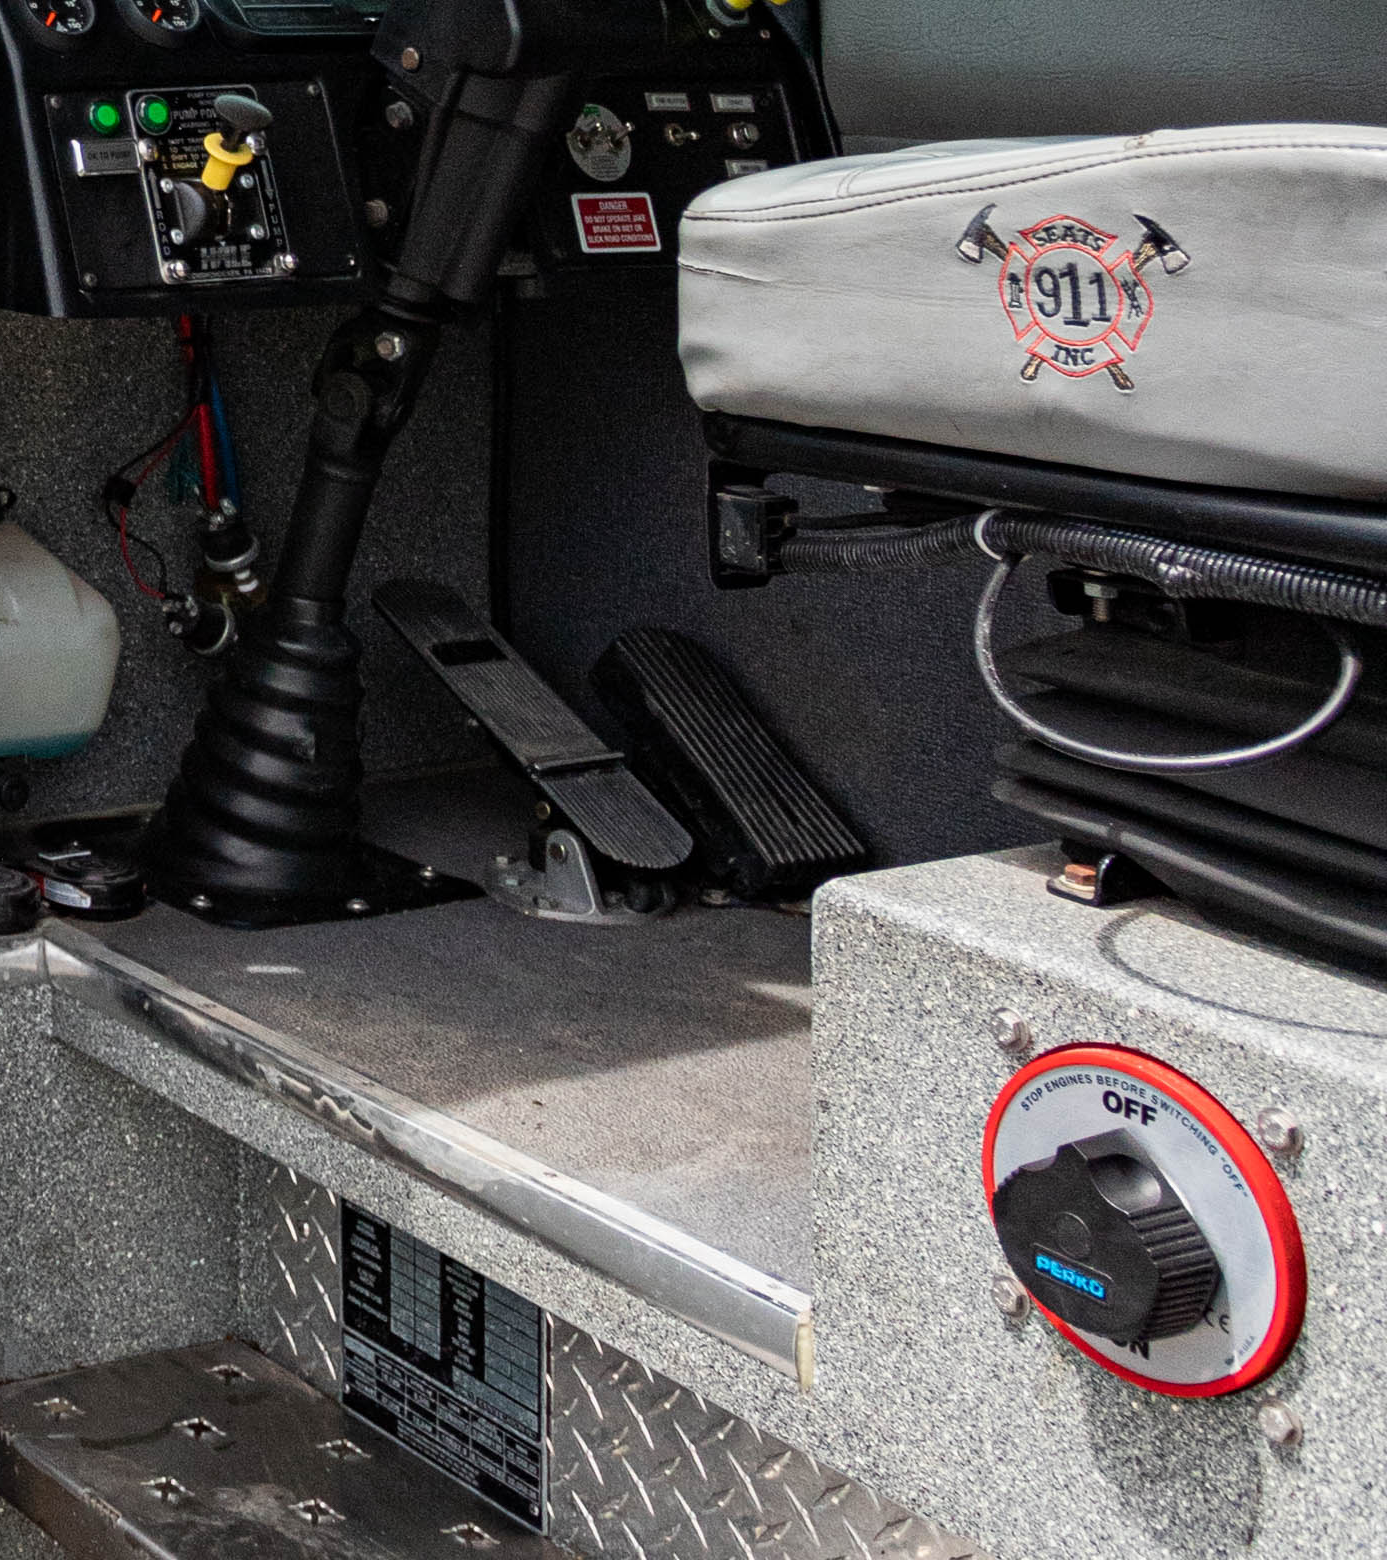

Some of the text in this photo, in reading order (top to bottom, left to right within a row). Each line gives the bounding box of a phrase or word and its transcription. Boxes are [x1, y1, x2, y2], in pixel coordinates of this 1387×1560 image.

[584, 215, 594, 224] DO
[593, 215, 606, 224] NOT
[606, 214, 632, 223] OPERATE
[598, 200, 628, 211] DANGER
[156, 210, 172, 256] ROAD
[268, 202, 283, 249] PUMP
[586, 235, 603, 243] SLICK
[1032, 224, 1107, 252] SEATS
[1034, 262, 1112, 328] 911
[1050, 343, 1096, 366] INC
[1101, 1089, 1158, 1127] OFF
[1020, 1073, 1250, 1198] STOP ENGINES BEFORE SWITCHING "OFF"
[1035, 1253, 1105, 1300] PERKO
[1113, 1338, 1151, 1360] N
